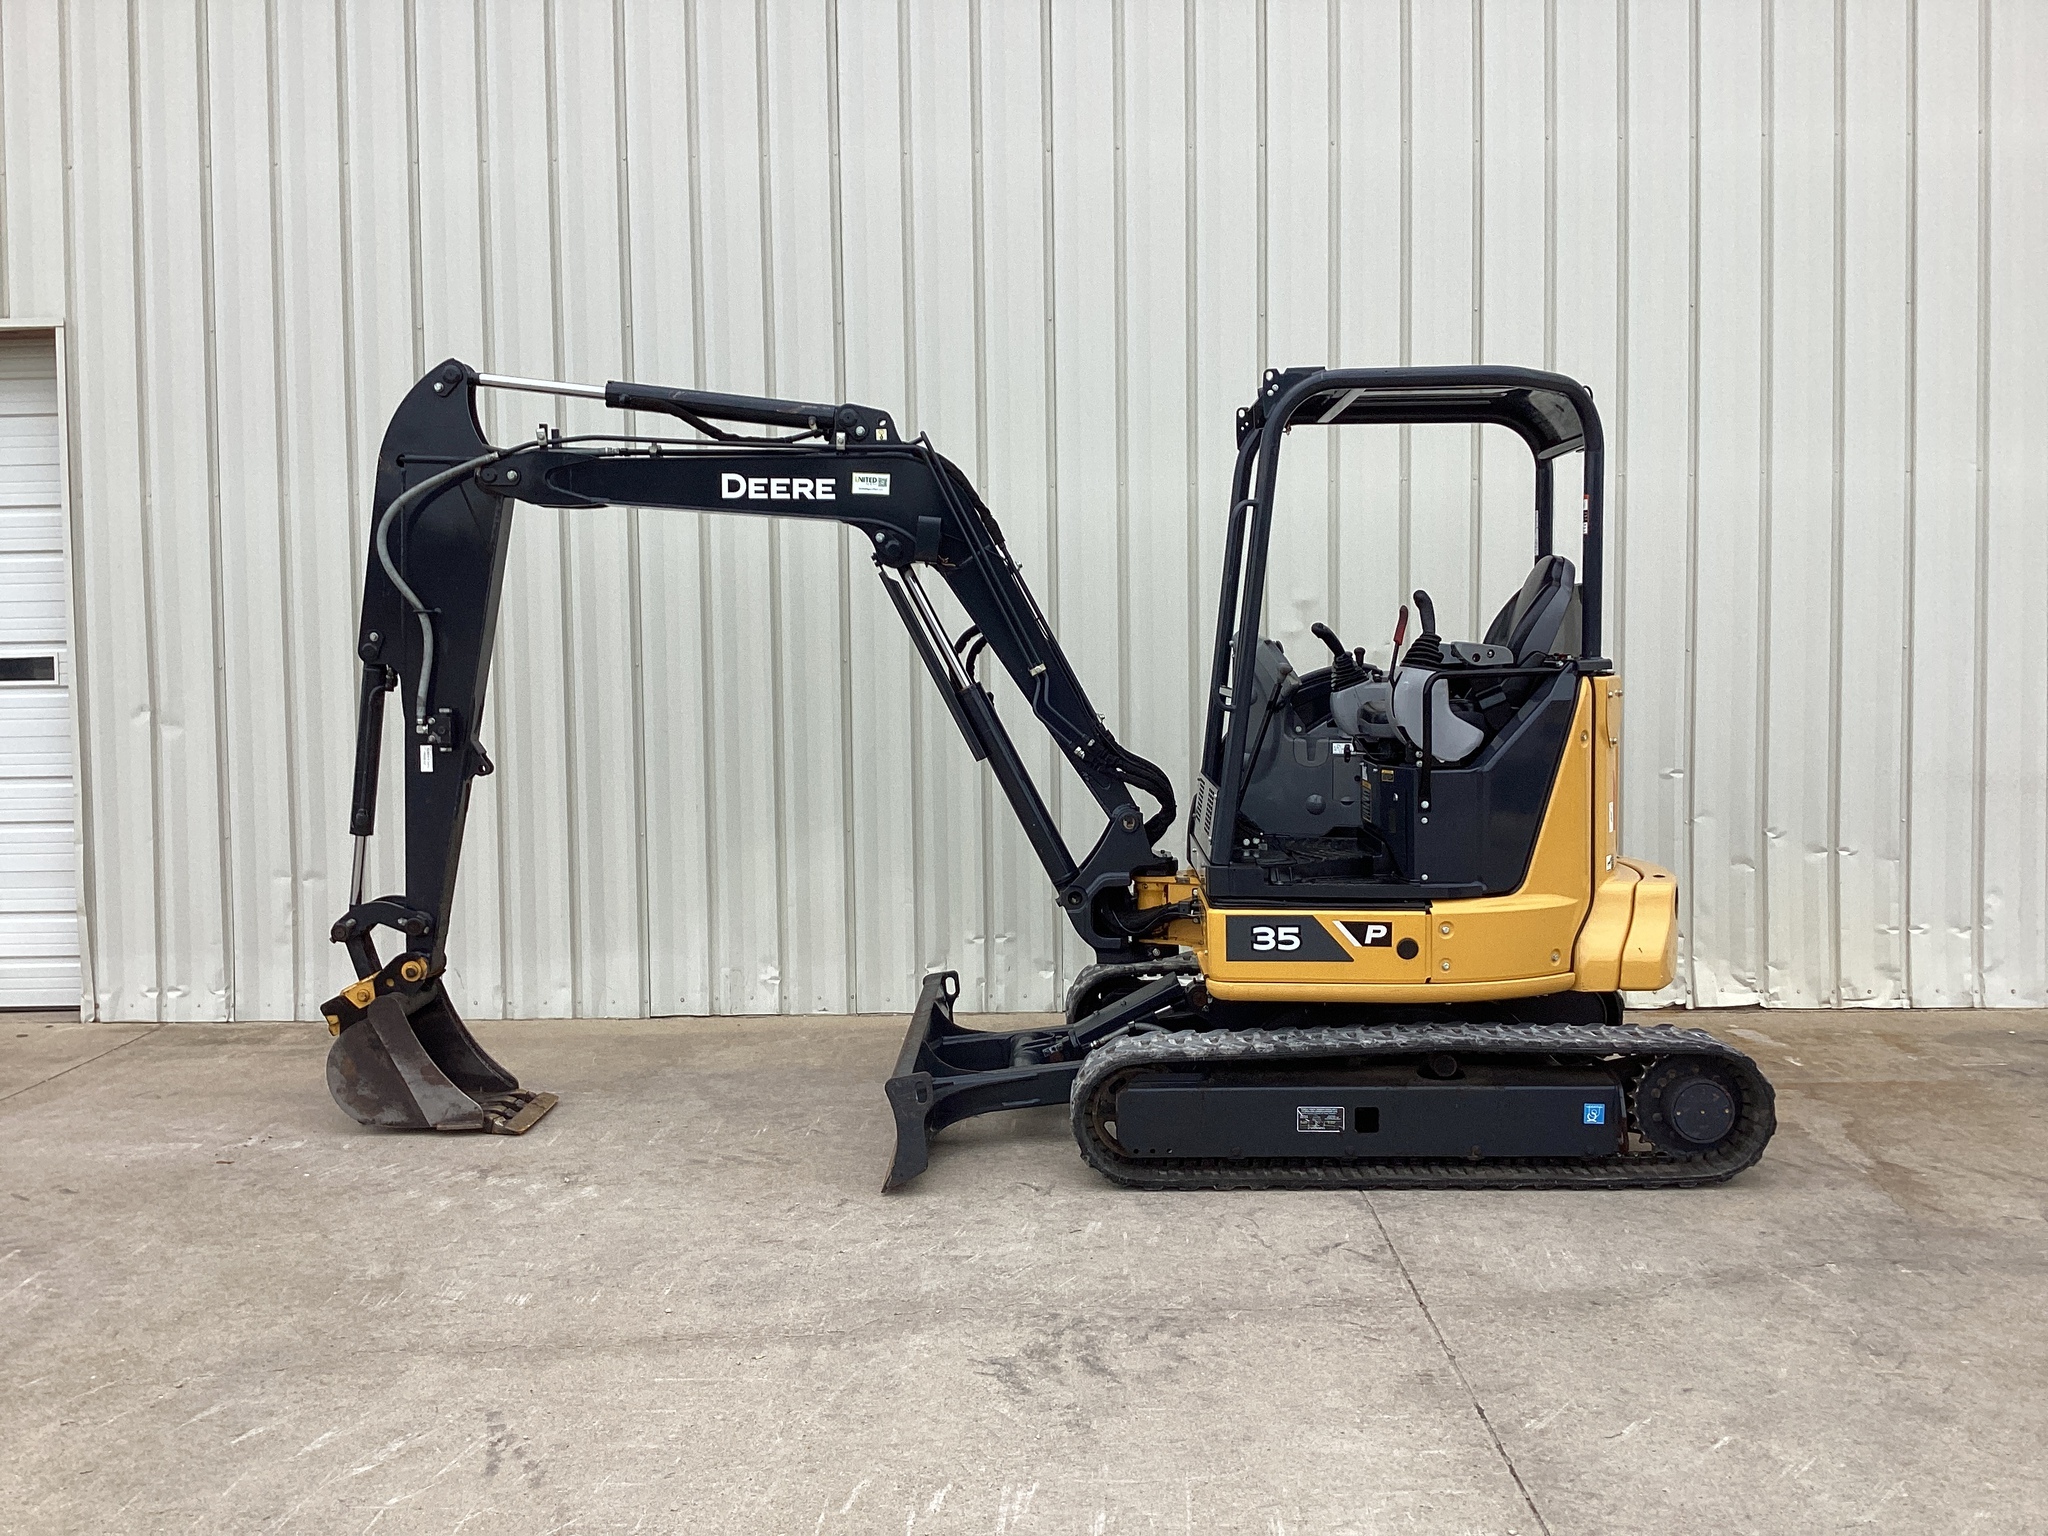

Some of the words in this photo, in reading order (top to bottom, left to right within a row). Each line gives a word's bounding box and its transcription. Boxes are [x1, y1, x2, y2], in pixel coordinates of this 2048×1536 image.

[721, 472, 836, 500] DEERE
[1252, 926, 1301, 951] 35
[1364, 924, 1388, 944] P
